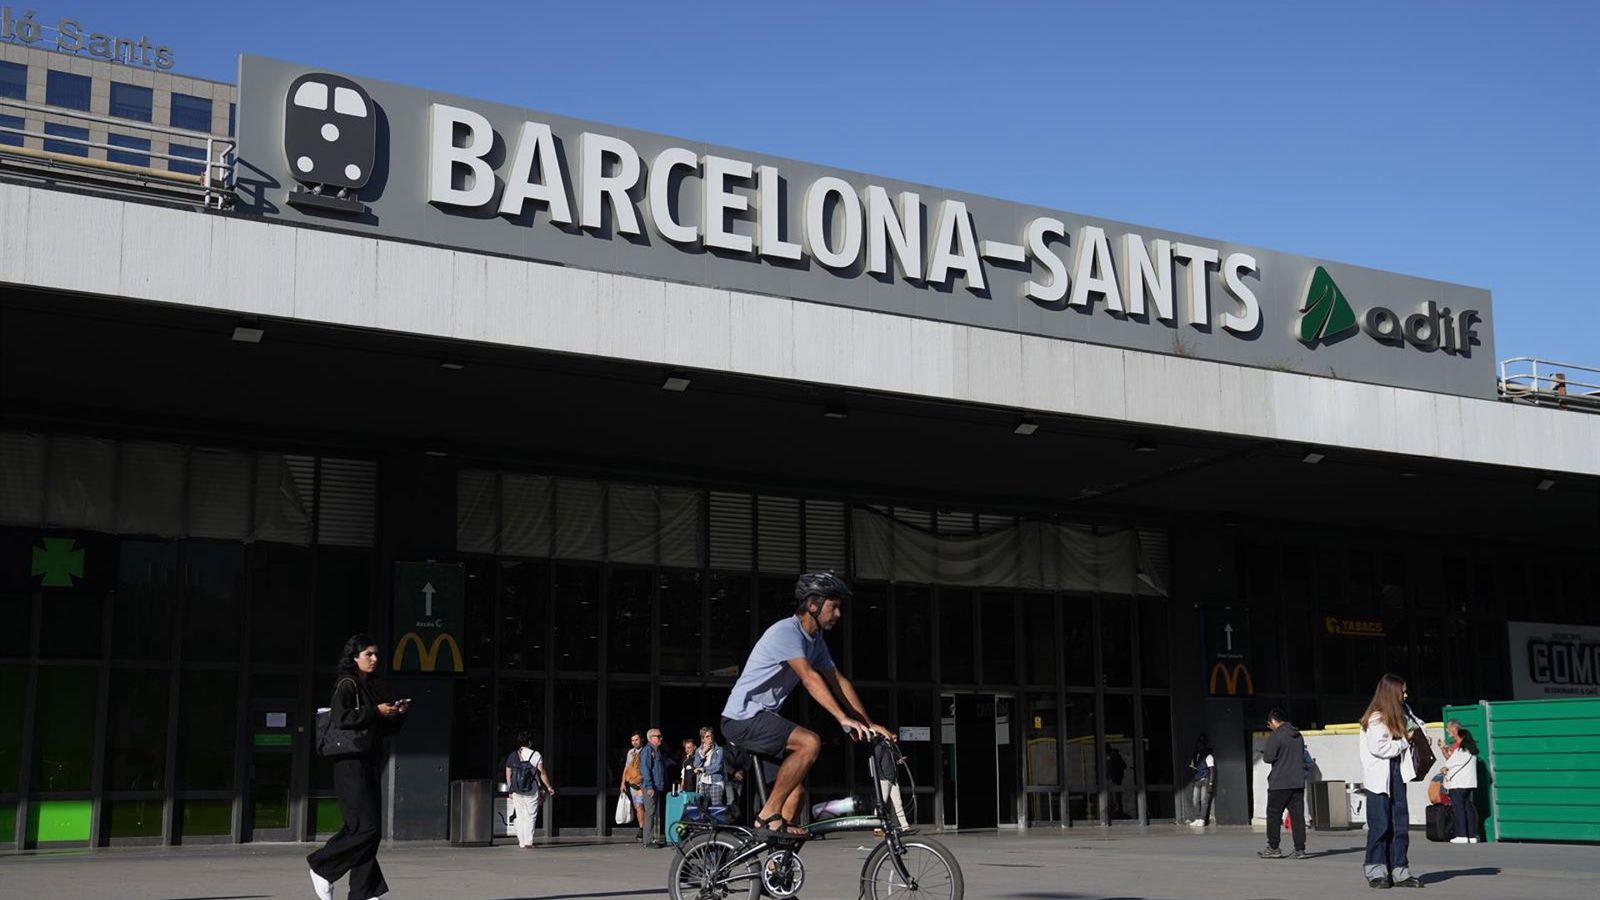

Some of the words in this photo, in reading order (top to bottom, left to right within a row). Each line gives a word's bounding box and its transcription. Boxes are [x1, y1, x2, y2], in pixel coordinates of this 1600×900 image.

[58, 18, 174, 69] Sants
[428, 102, 1260, 333] BARCELONA-SANTS
[1361, 300, 1482, 355] adif
[1342, 619, 1384, 633] TABACS
